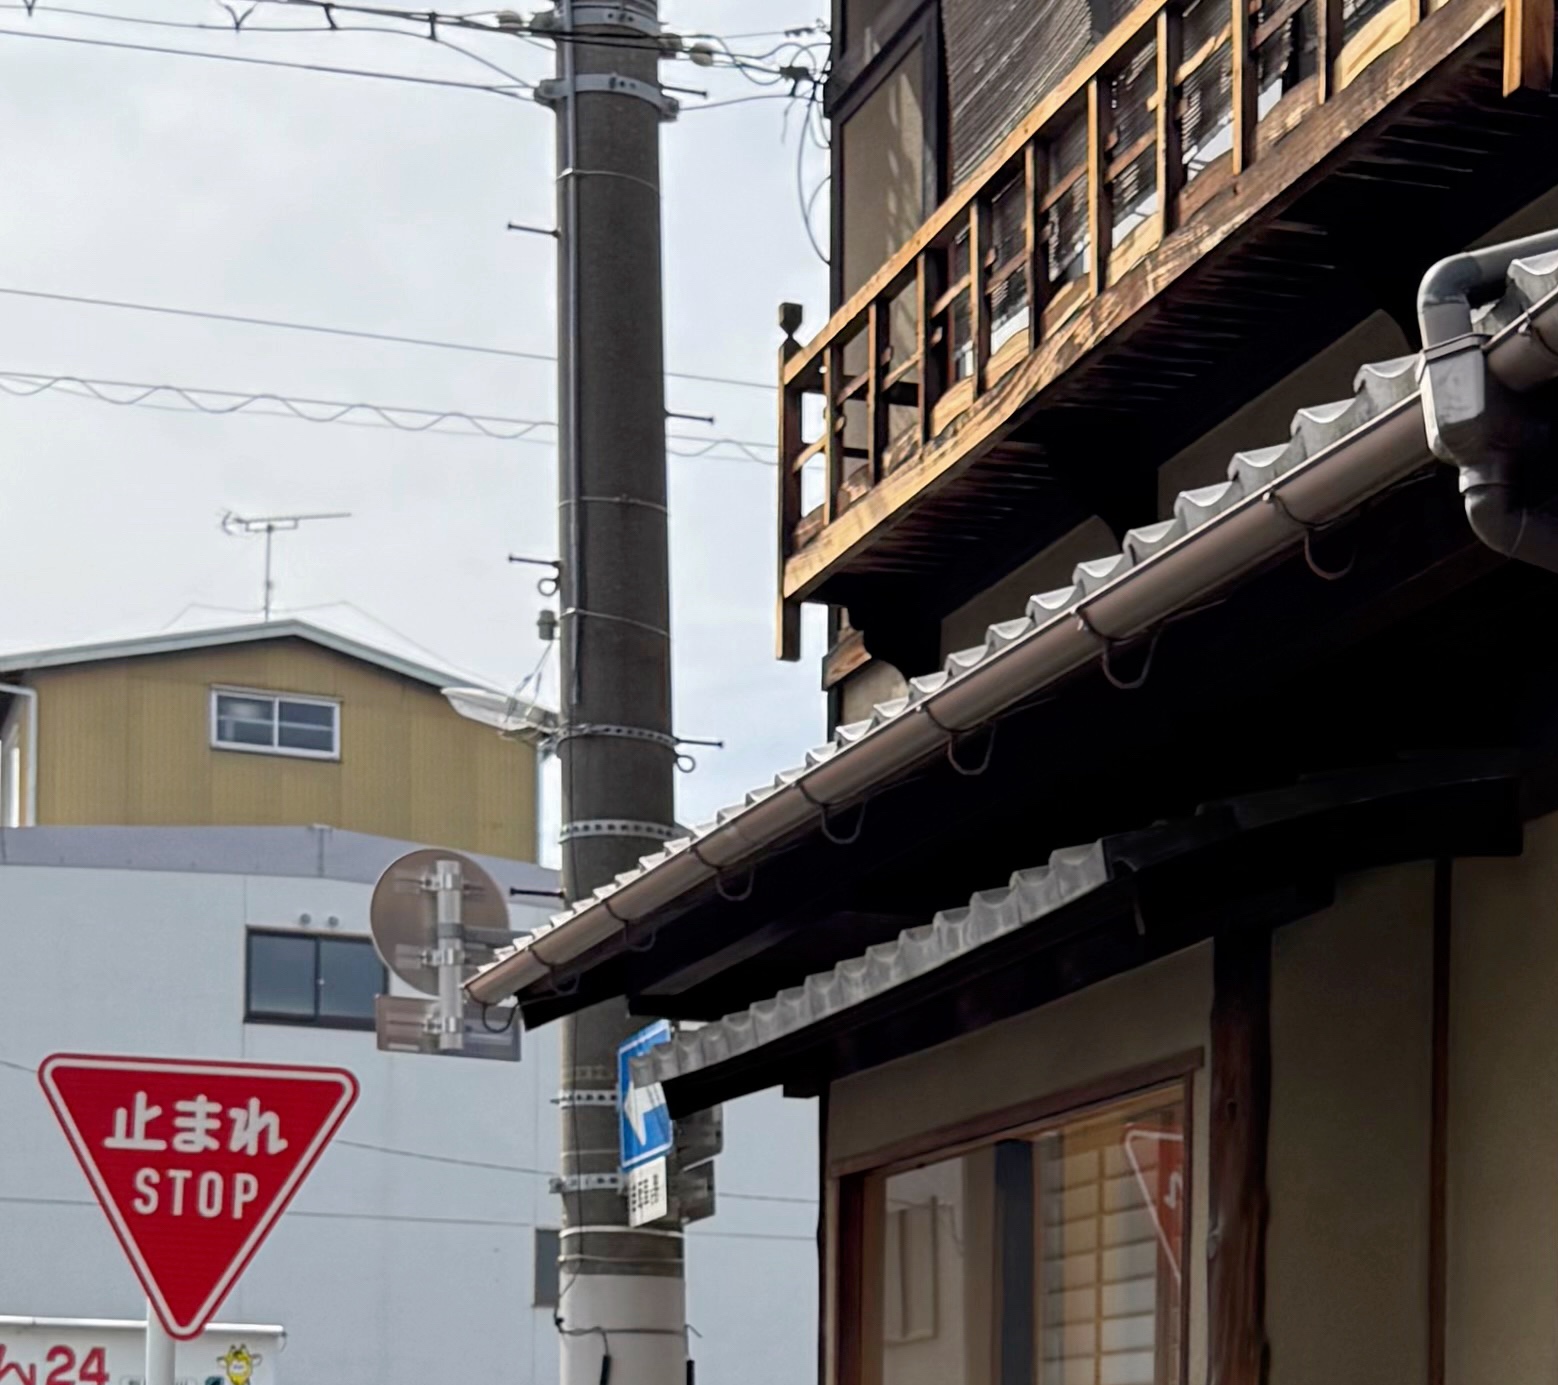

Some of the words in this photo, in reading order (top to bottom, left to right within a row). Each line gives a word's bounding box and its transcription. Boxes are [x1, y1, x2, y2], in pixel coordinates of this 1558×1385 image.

[104, 1091, 289, 1156] 止まれ
[132, 1167, 259, 1219] STOP
